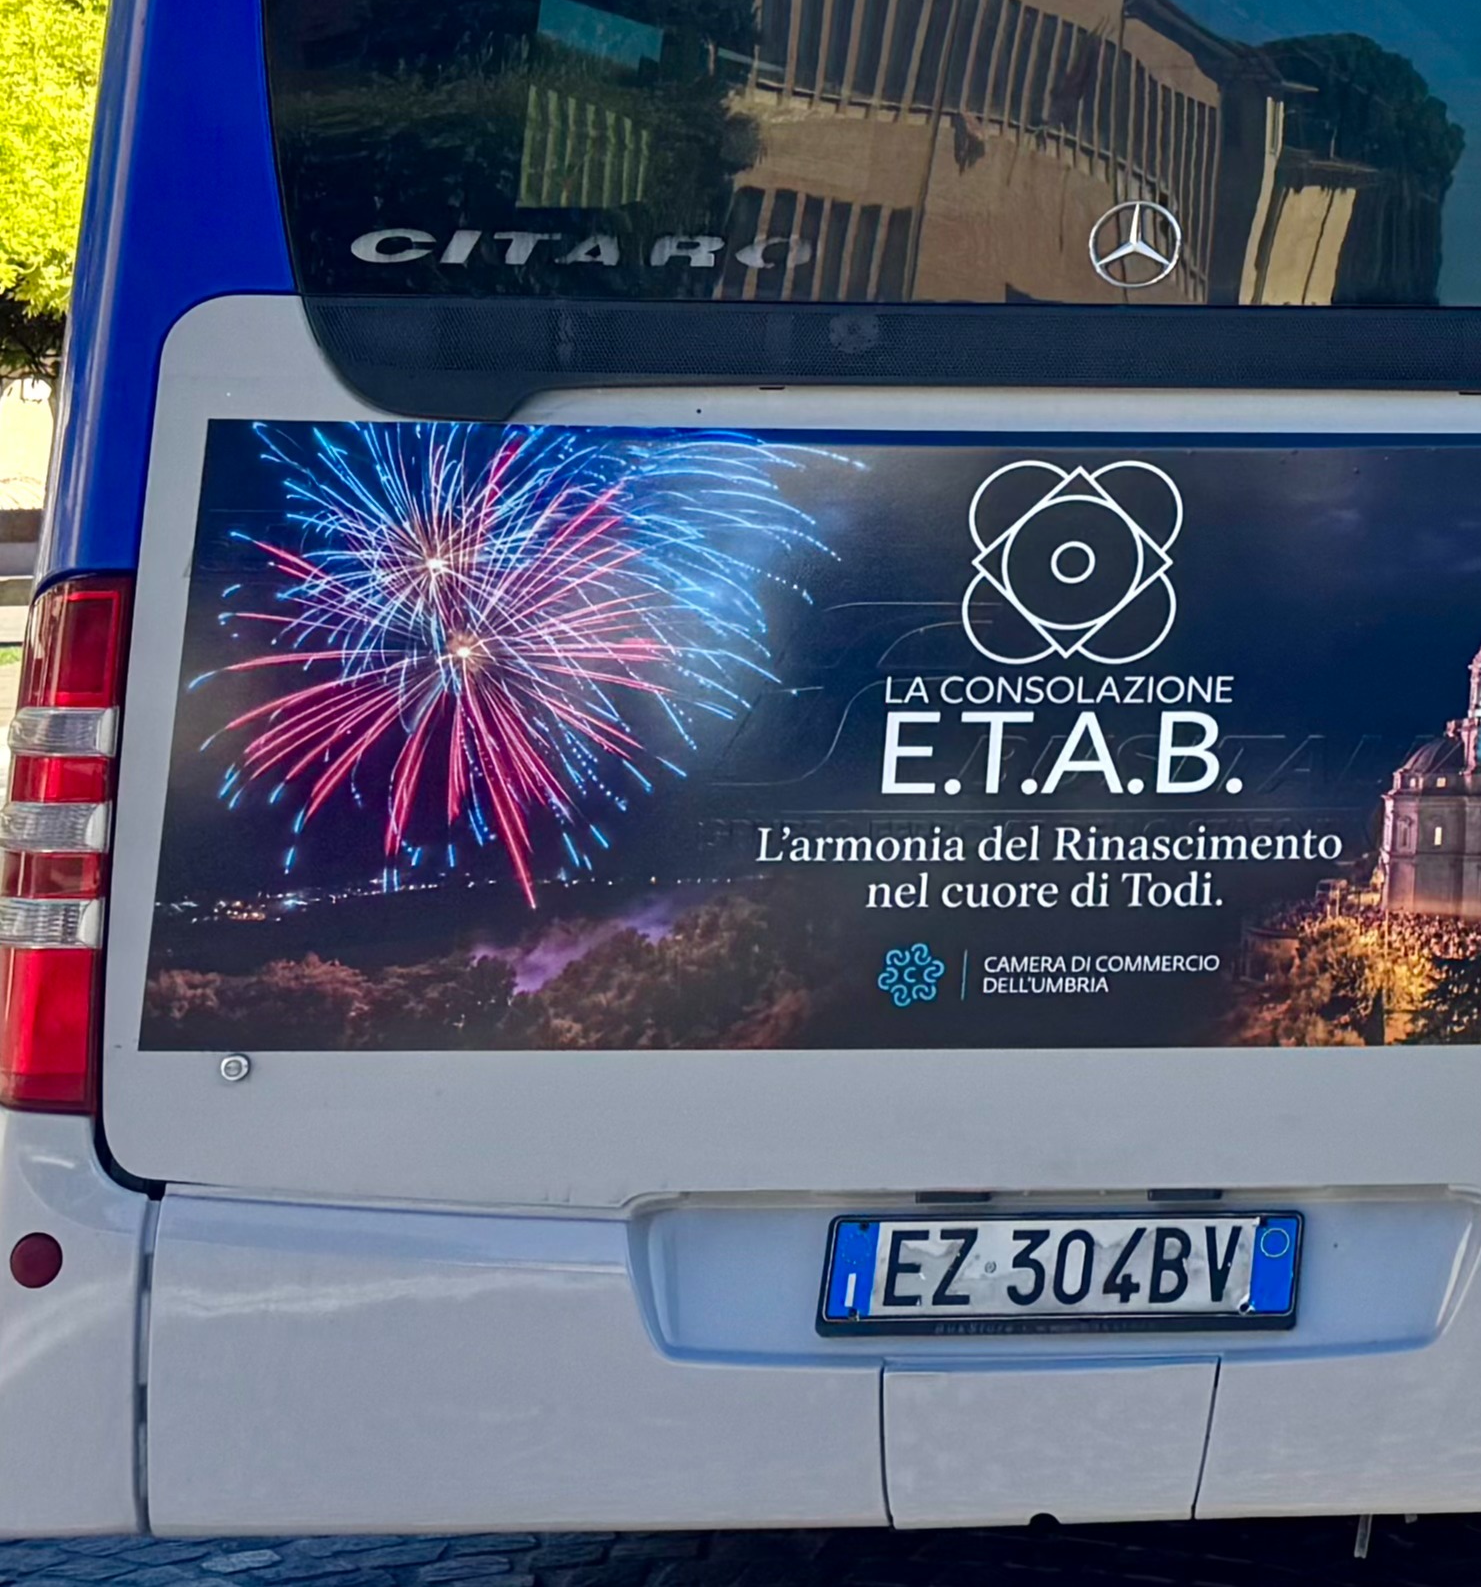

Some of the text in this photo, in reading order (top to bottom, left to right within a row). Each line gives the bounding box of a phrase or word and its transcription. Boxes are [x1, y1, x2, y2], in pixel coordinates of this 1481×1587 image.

[350, 228, 812, 269] CITARO
[885, 676, 1234, 704] LA CONSOLAZIONE
[881, 711, 1243, 795] E.T.A.B.
[755, 826, 965, 863] L’armonia
[977, 825, 1039, 861] del
[1053, 826, 1343, 861] Rinascimento
[866, 871, 1224, 908] nel cuore di Todi.
[984, 954, 1221, 973] CAMERA DI COMMERCIO
[983, 976, 1110, 994] DELL'UMBRIA
[883, 1228, 979, 1307] EZ
[1006, 1226, 1242, 1306] 304BV
